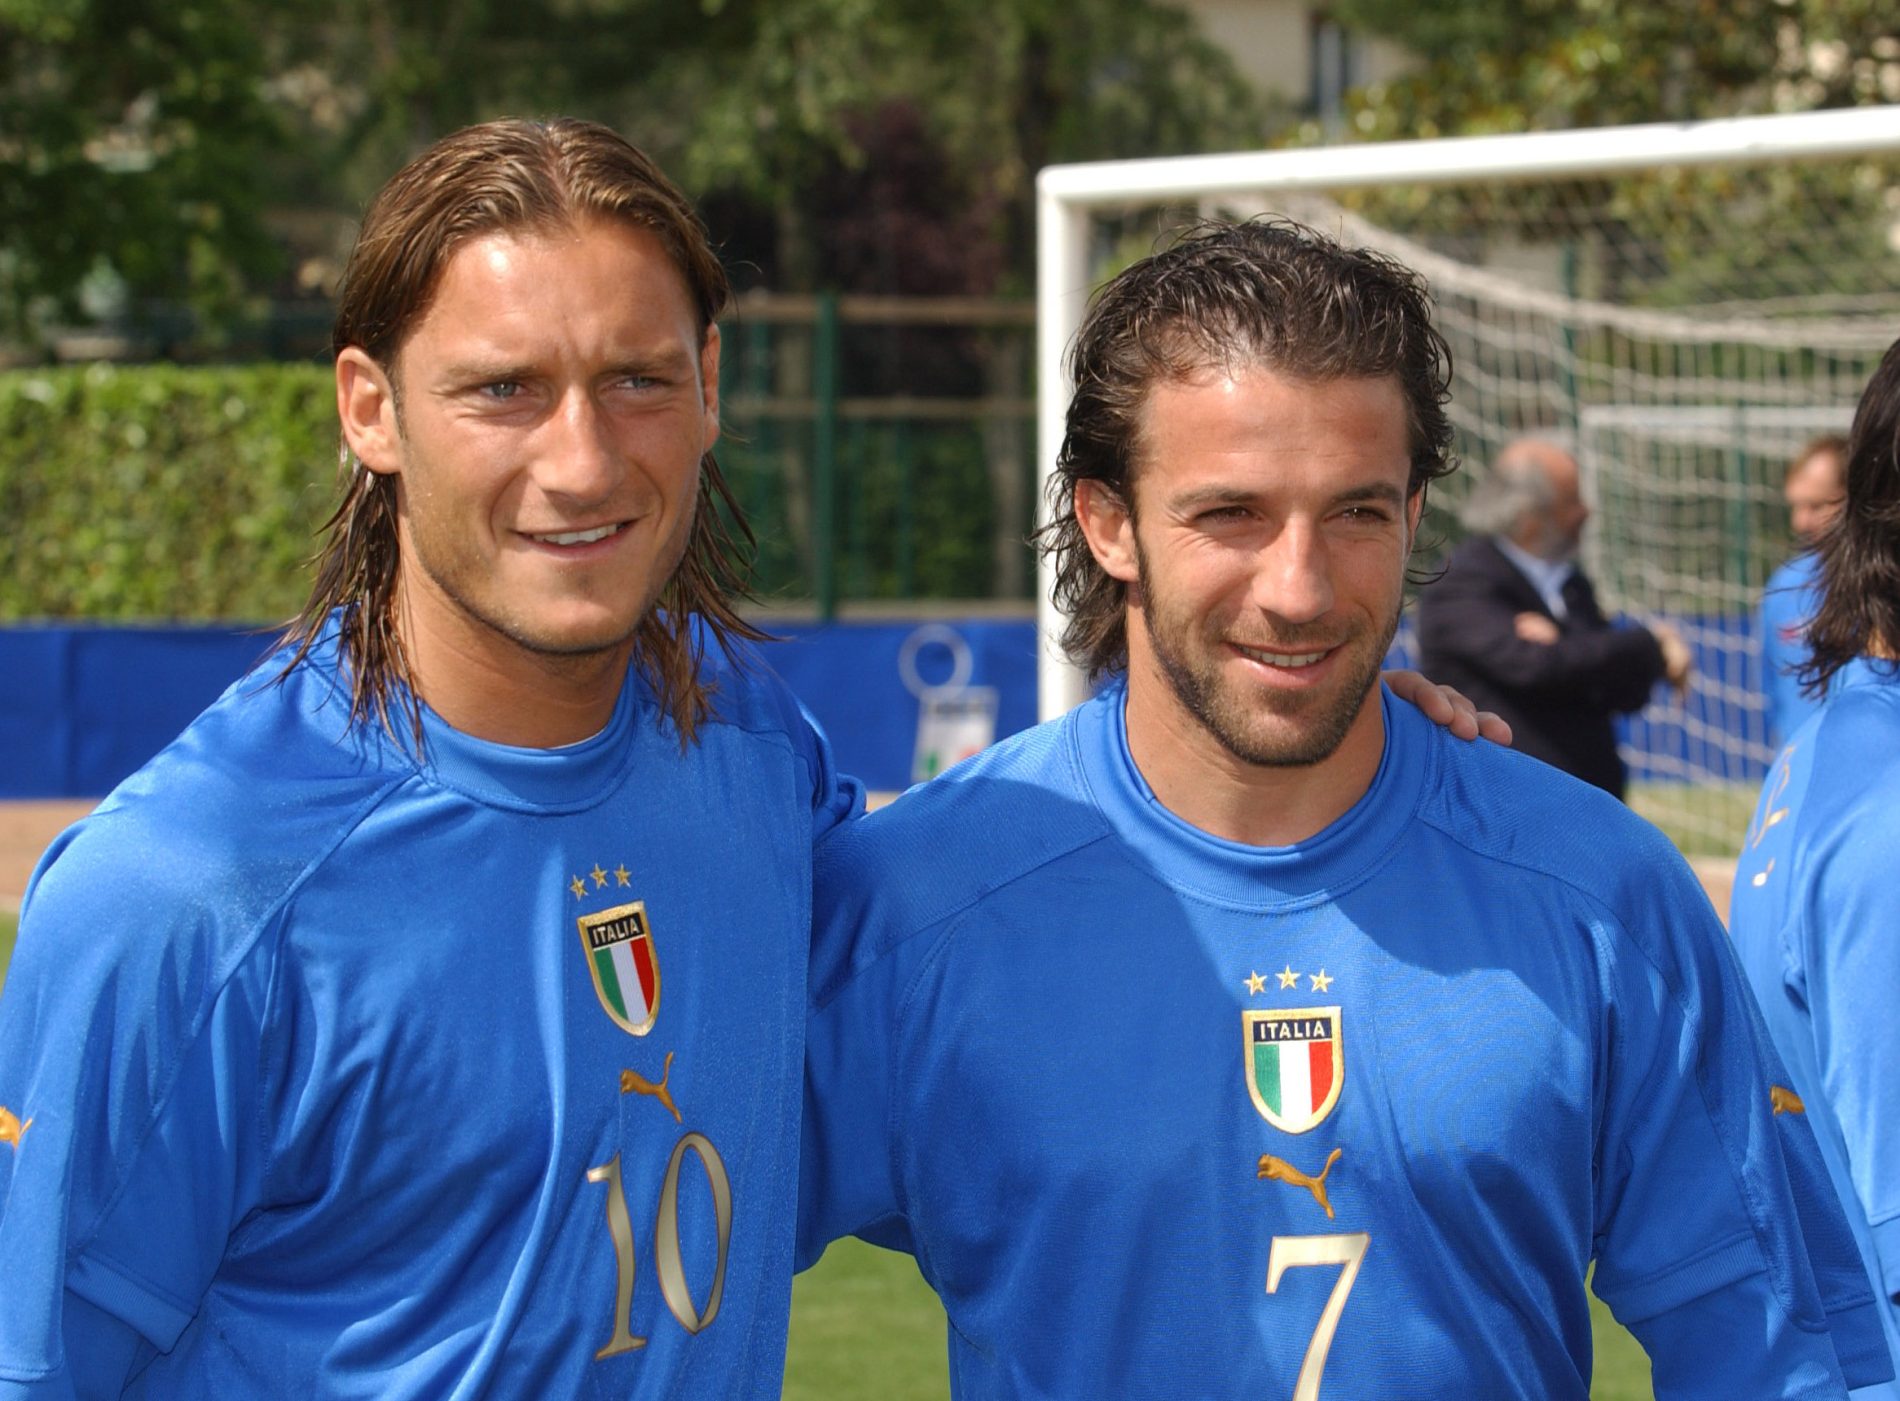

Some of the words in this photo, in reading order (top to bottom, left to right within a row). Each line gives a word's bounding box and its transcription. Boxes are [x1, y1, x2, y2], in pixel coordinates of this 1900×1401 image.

[592, 918, 640, 945] ITALIA
[1260, 1020, 1326, 1040] ITALIA
[586, 1131, 733, 1361] 10
[1265, 1231, 1372, 1401] 7
